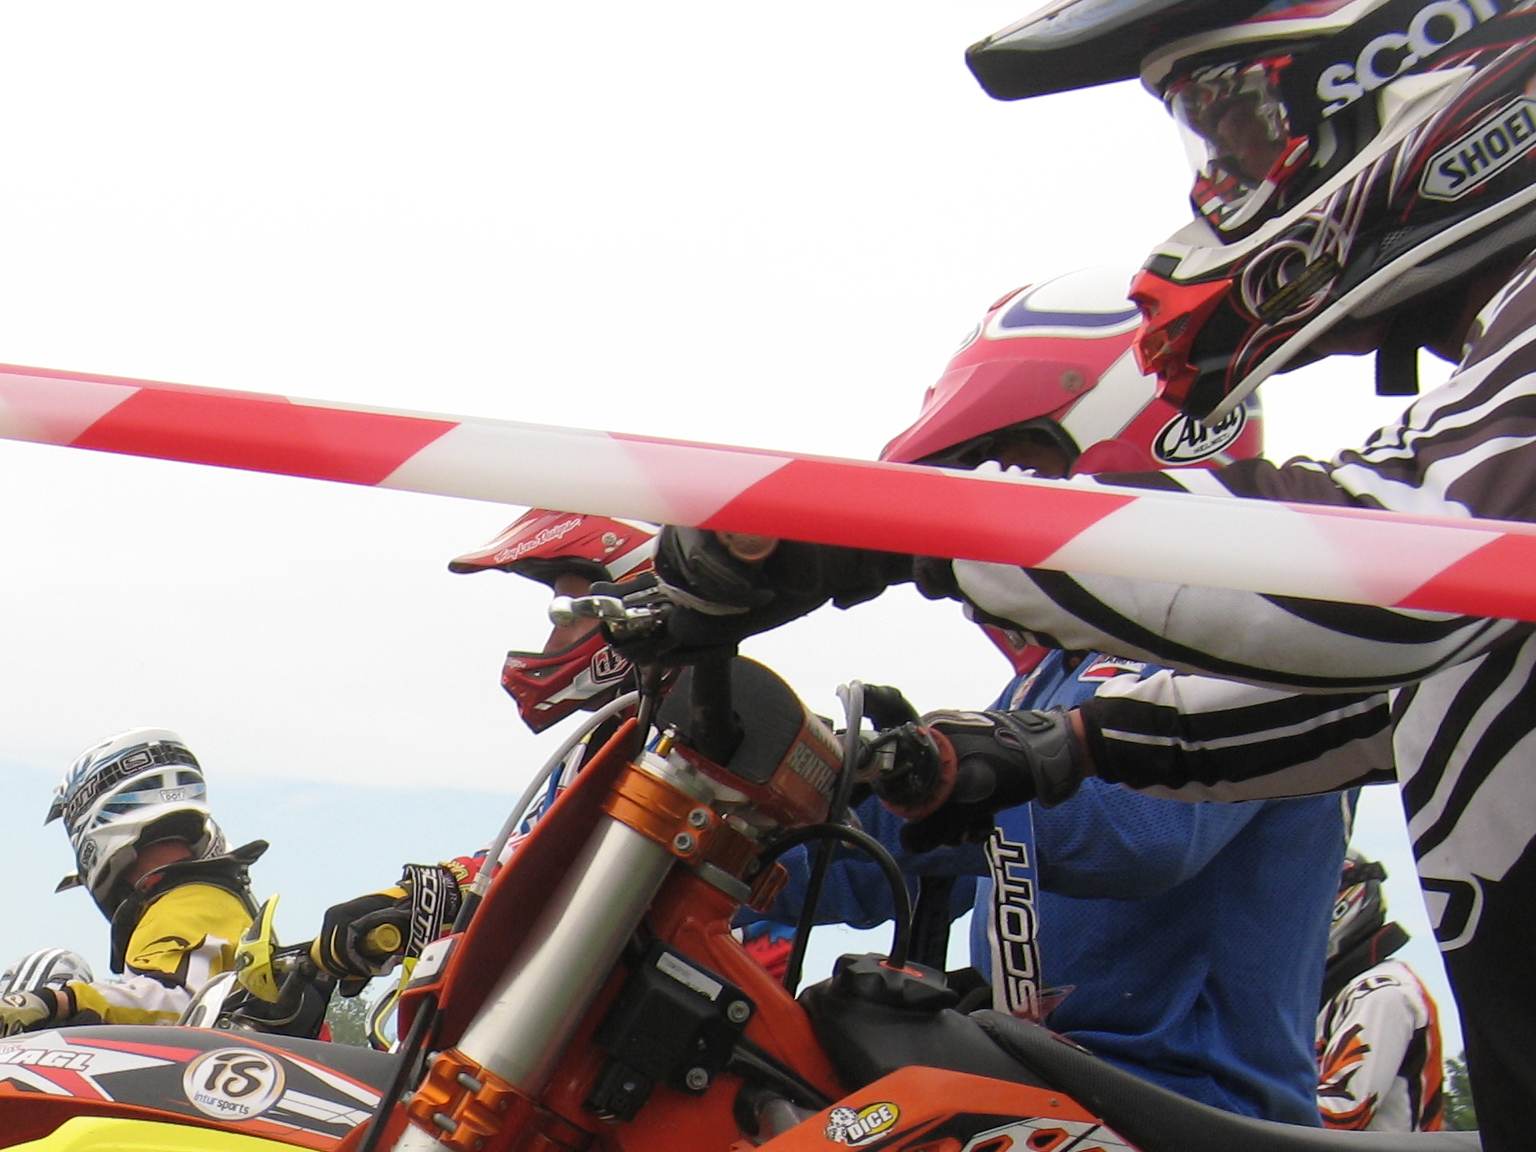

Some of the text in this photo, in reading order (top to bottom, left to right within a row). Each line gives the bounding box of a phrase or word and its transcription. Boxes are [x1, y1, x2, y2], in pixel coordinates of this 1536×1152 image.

[989, 833, 1039, 1020] SCOTT
[217, 1099, 250, 1115] sports
[847, 1105, 894, 1141] DICE
